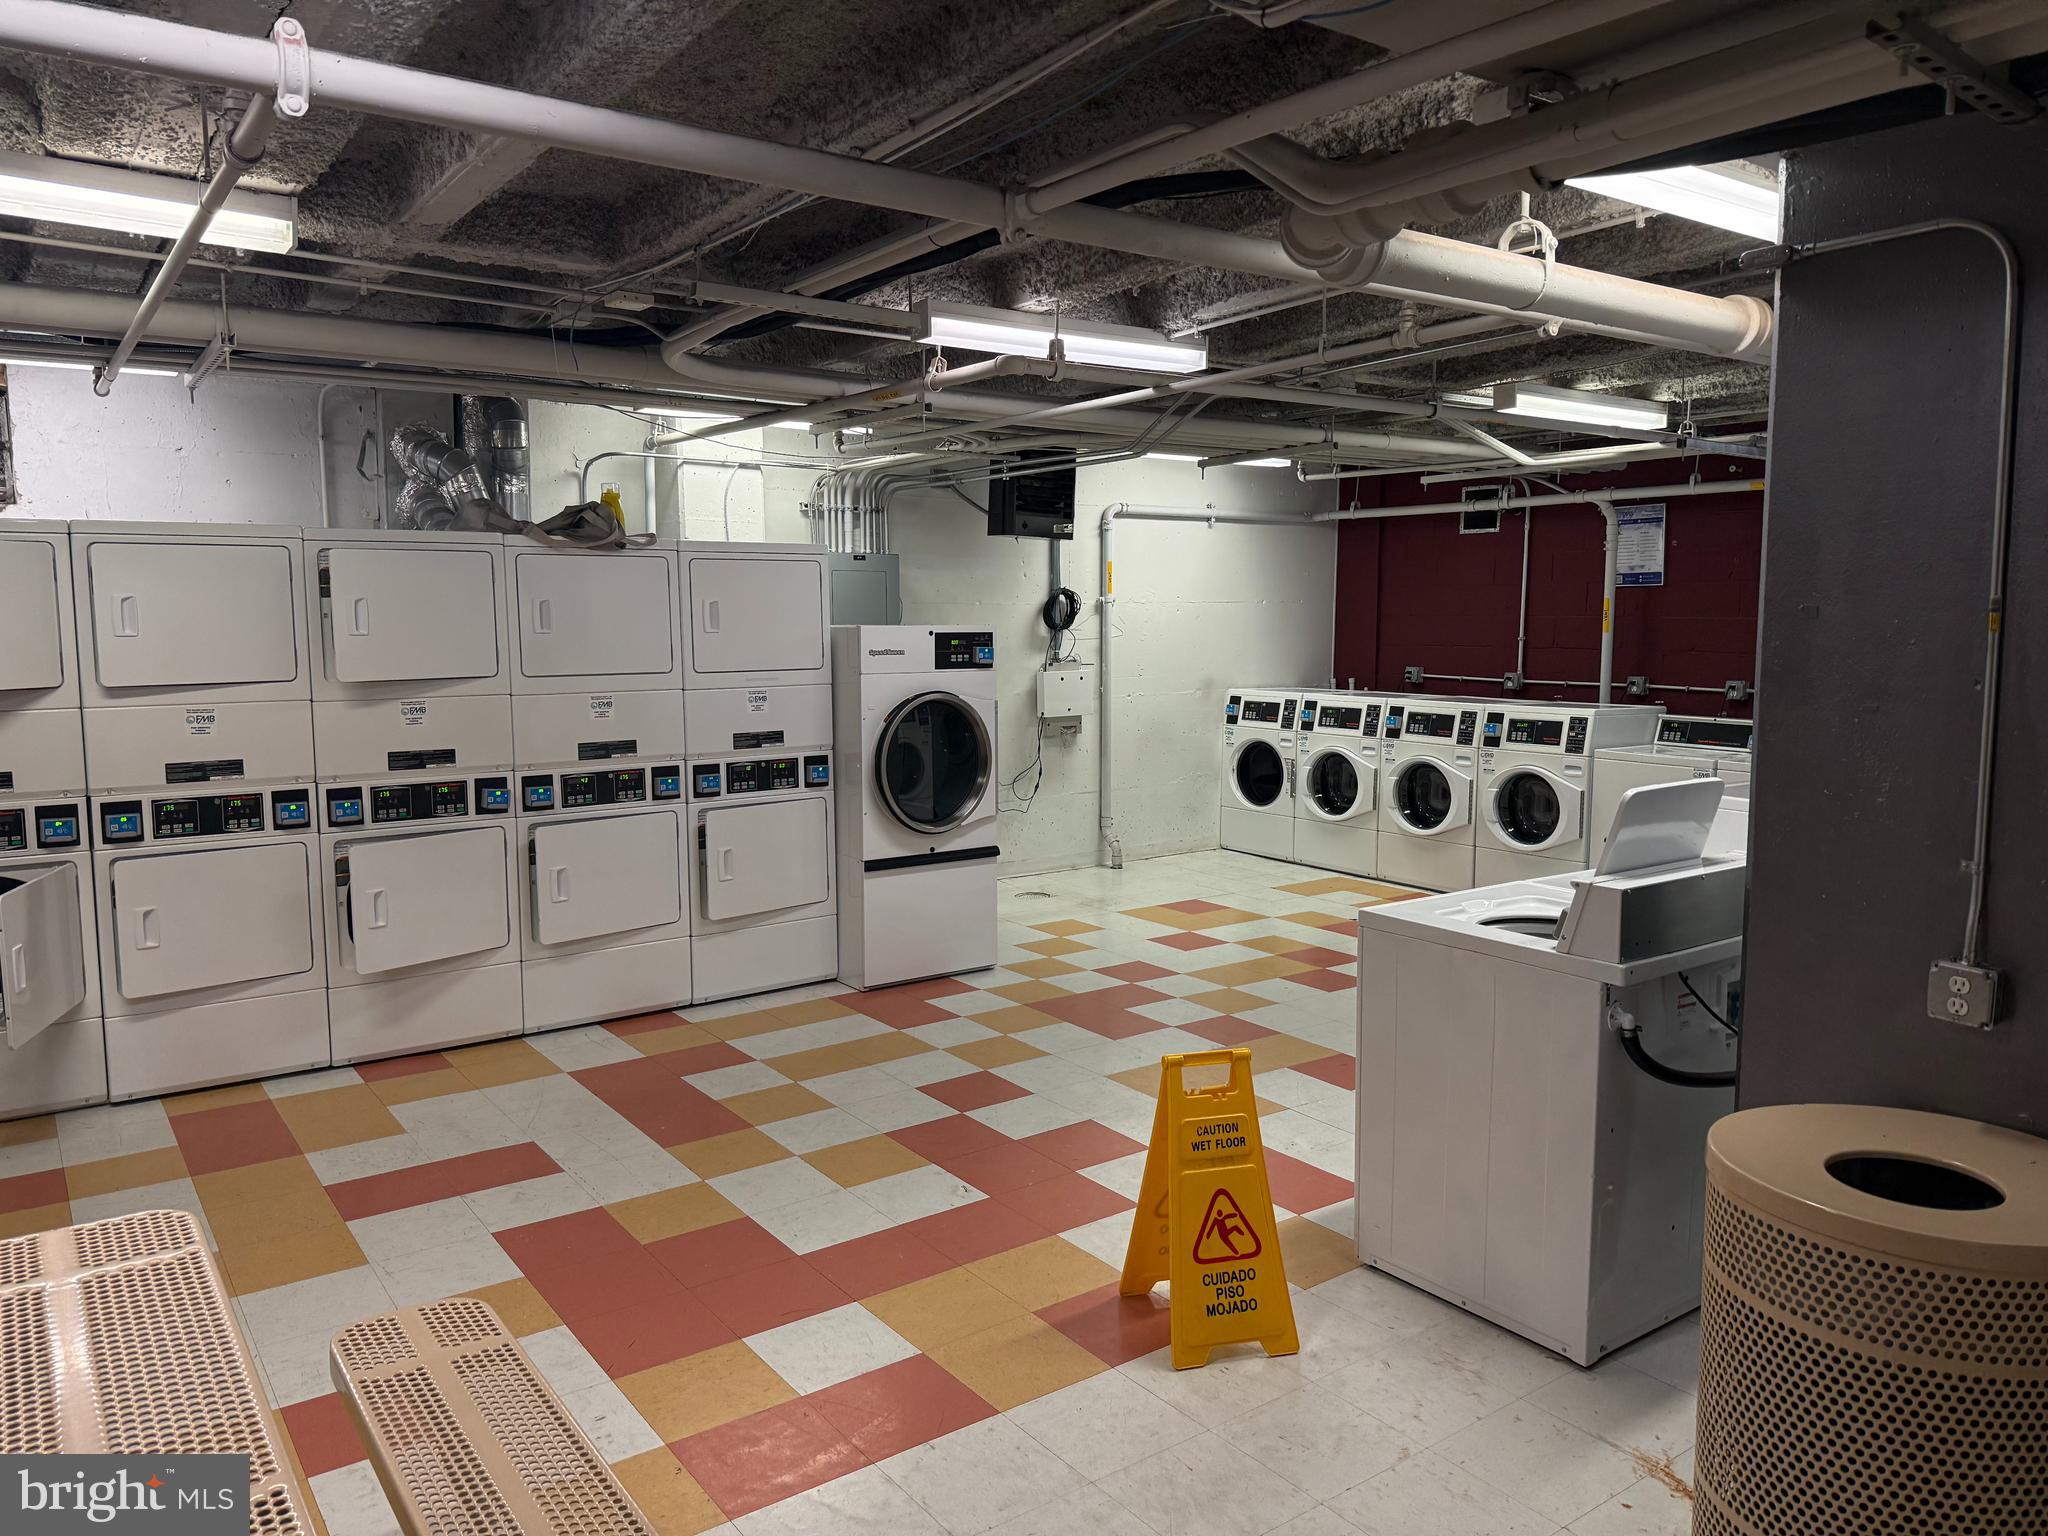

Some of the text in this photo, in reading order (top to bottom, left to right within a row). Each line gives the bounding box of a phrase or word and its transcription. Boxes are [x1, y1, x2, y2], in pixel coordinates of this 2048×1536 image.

[195, 714, 216, 724] FMB
[1196, 1122, 1239, 1137] CAUTION
[1191, 1136, 1247, 1152] WET FLOOR
[1202, 1267, 1256, 1287] CUIDADO
[1216, 1285, 1245, 1300] PISO
[1206, 1298, 1258, 1317] MOJADO
